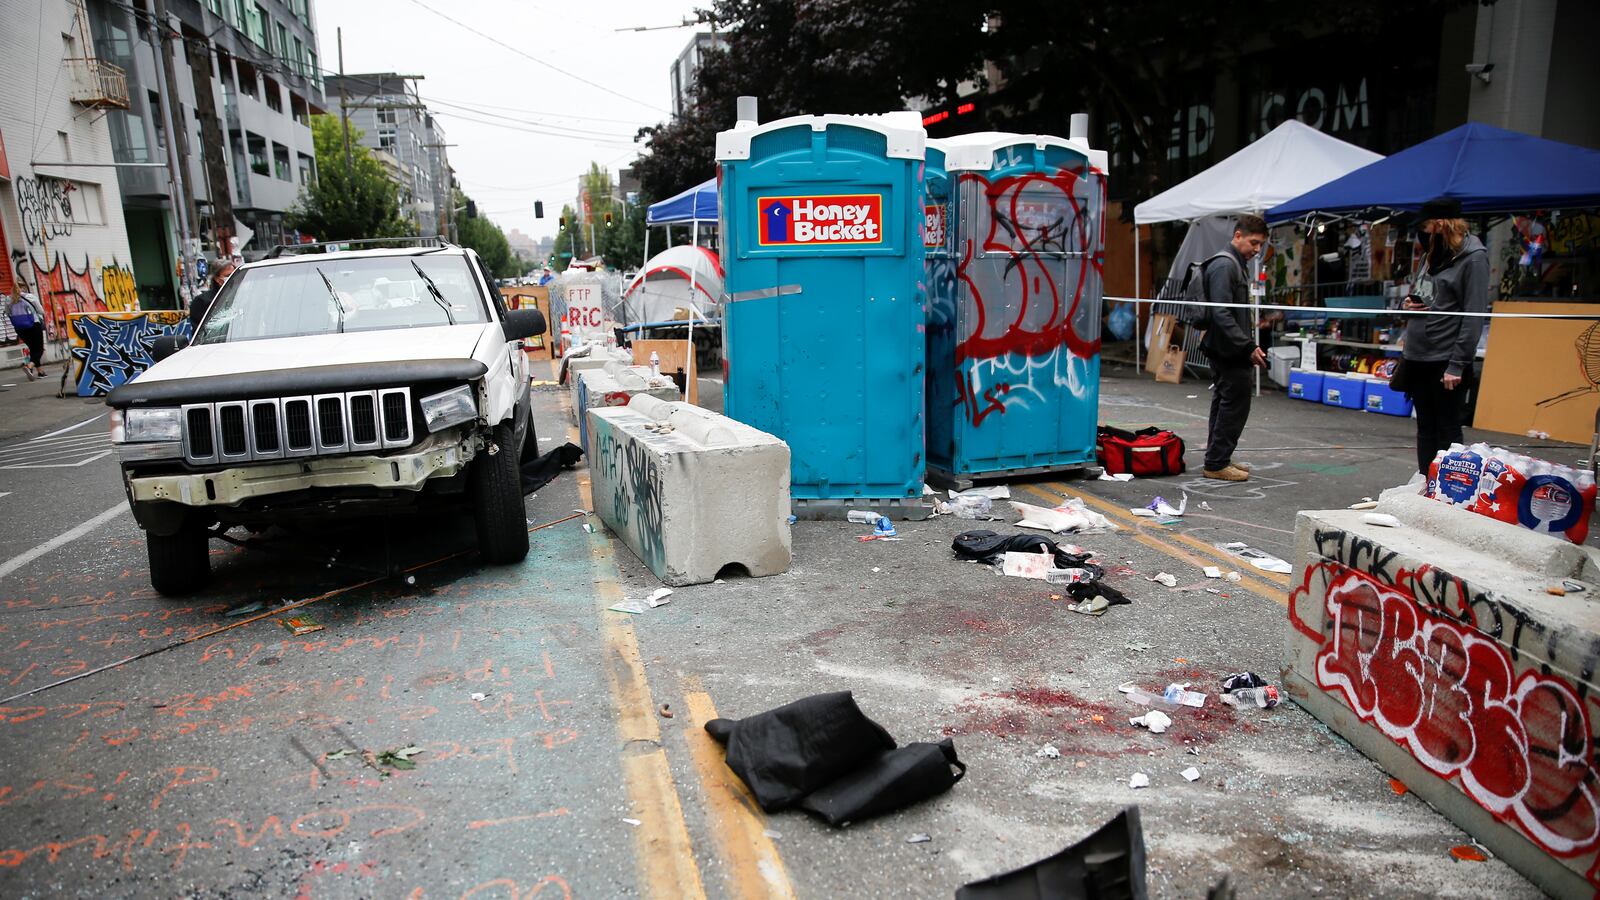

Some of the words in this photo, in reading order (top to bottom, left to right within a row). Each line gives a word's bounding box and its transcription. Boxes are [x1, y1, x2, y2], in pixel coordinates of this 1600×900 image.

[792, 199, 871, 225] Honey
[794, 218, 878, 242] Bucket
[569, 288, 591, 302] FTP
